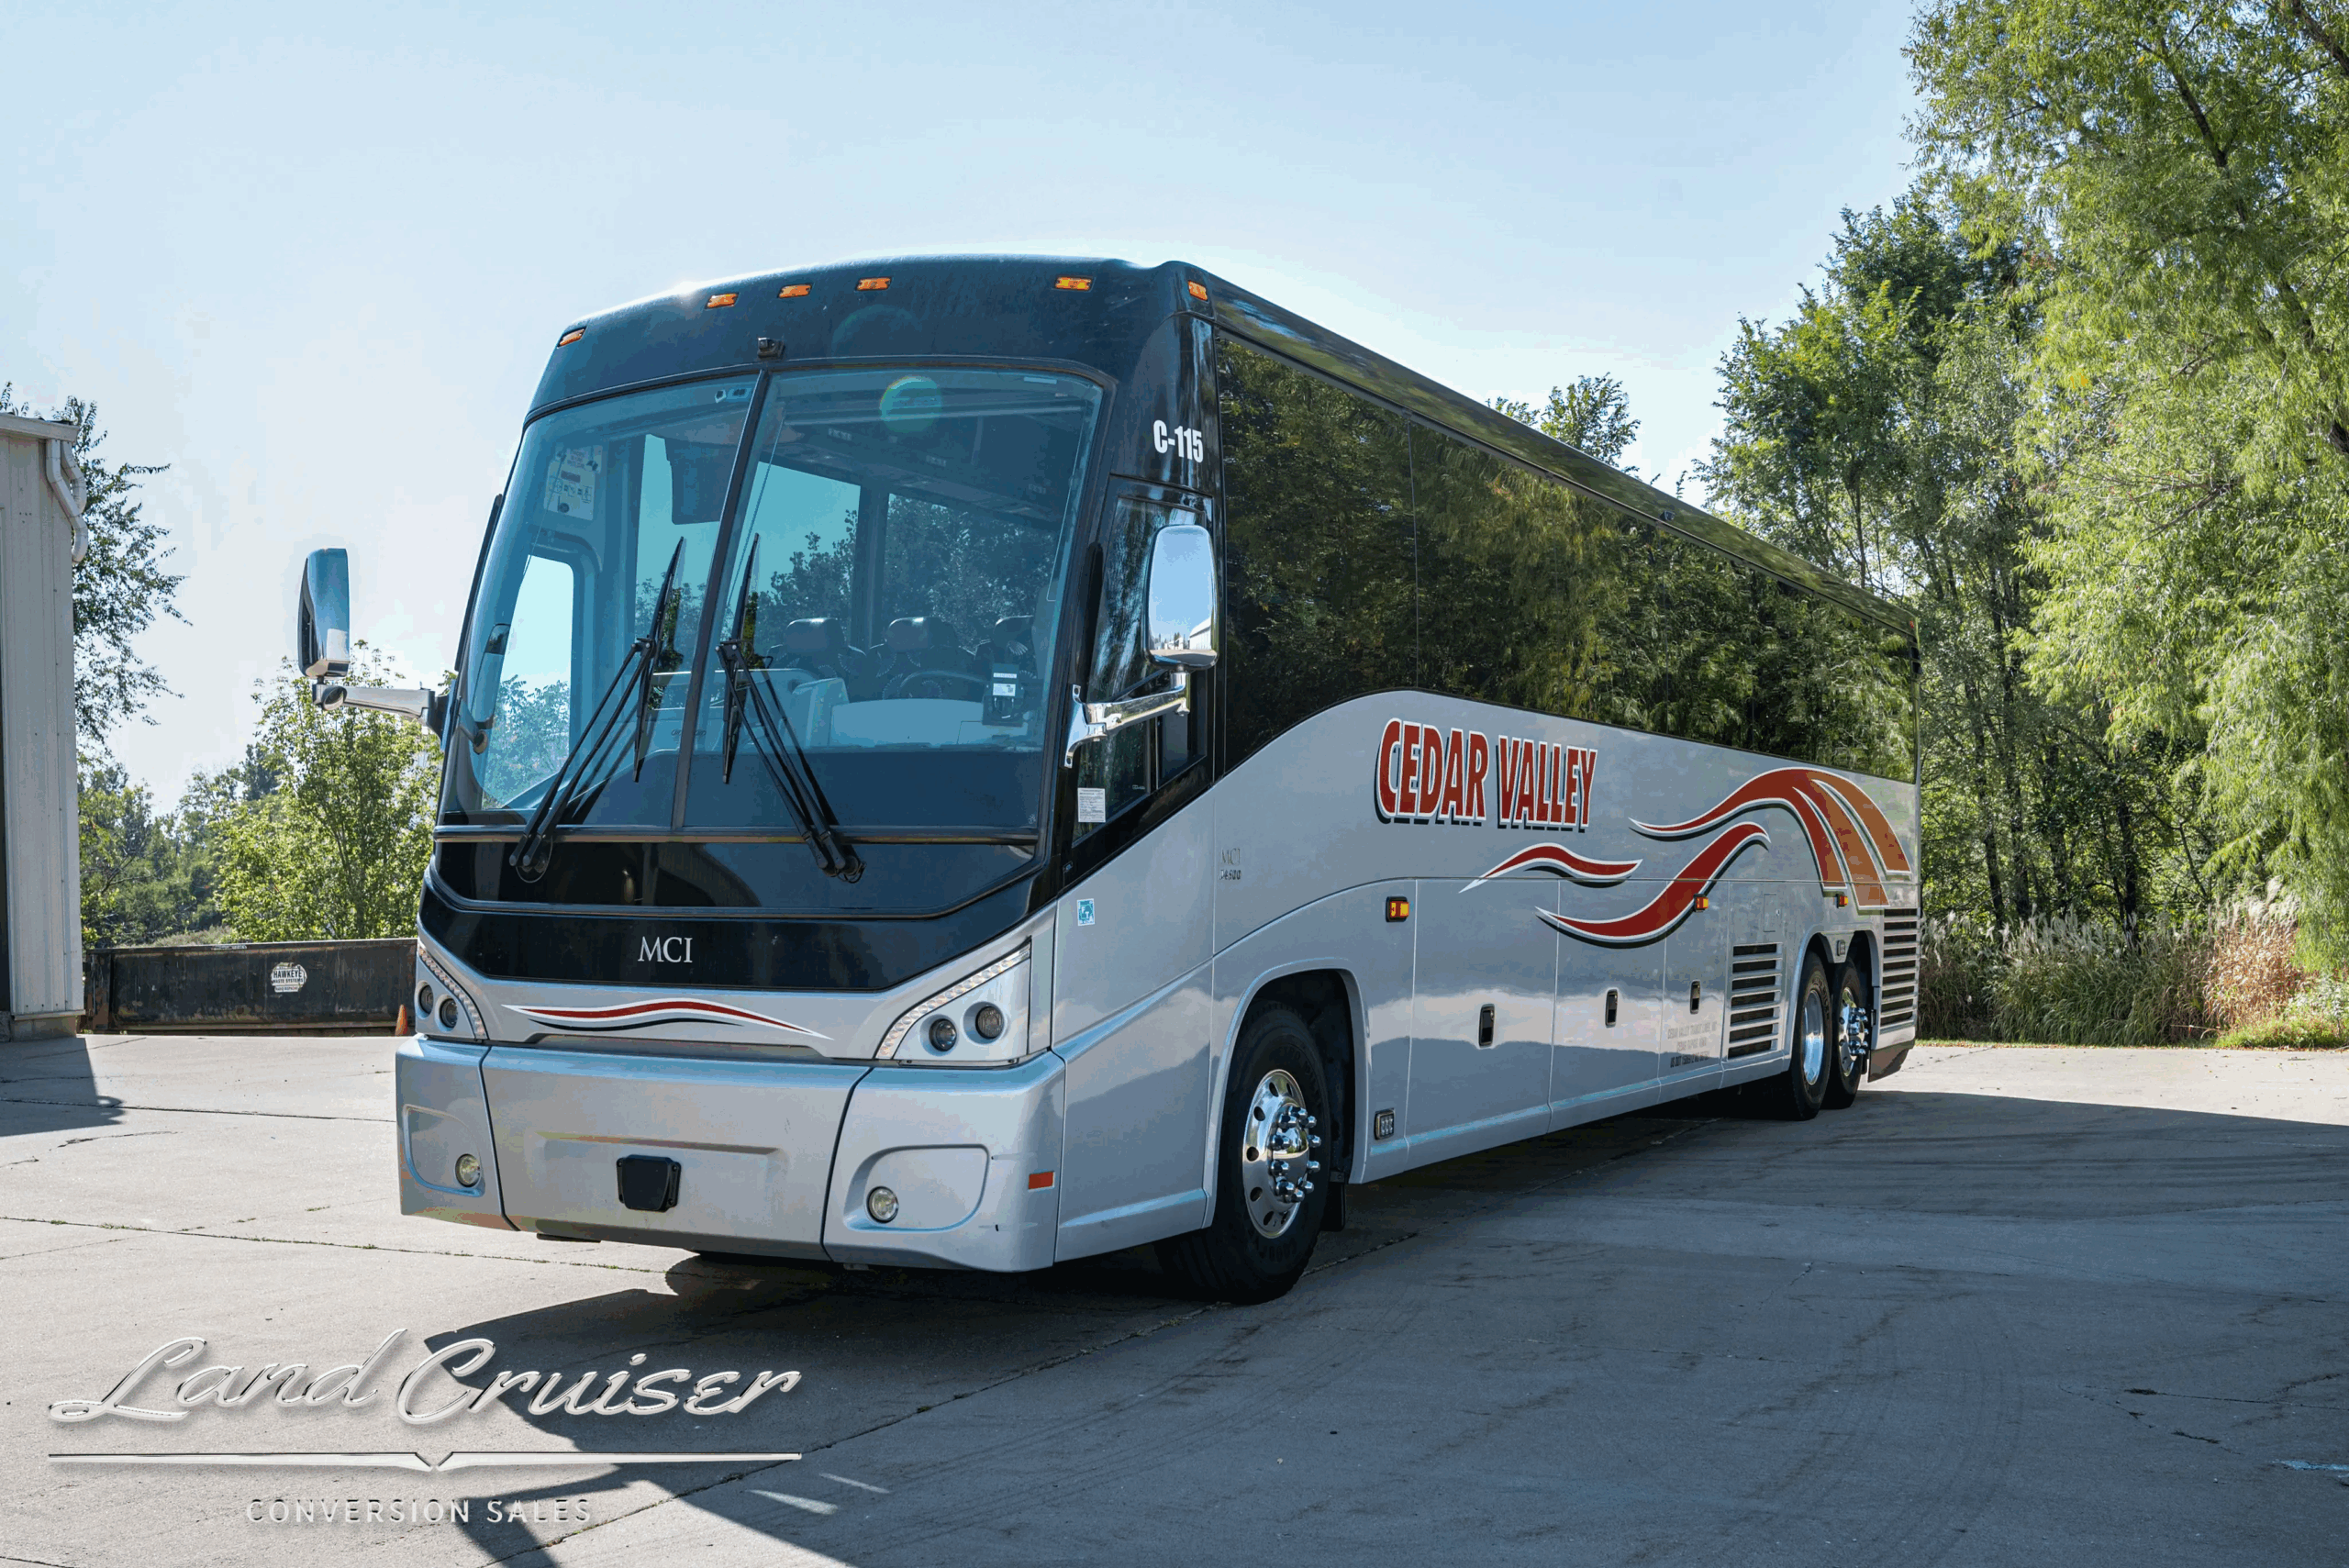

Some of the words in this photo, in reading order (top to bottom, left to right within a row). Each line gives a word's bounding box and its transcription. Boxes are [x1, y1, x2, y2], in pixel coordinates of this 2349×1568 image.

[1153, 419, 1204, 463] C-115
[1375, 717, 1489, 824] CEDAR
[1496, 735, 1598, 833] VALLEY
[638, 936, 693, 963] MCI
[273, 969, 303, 979] HAWKEYE
